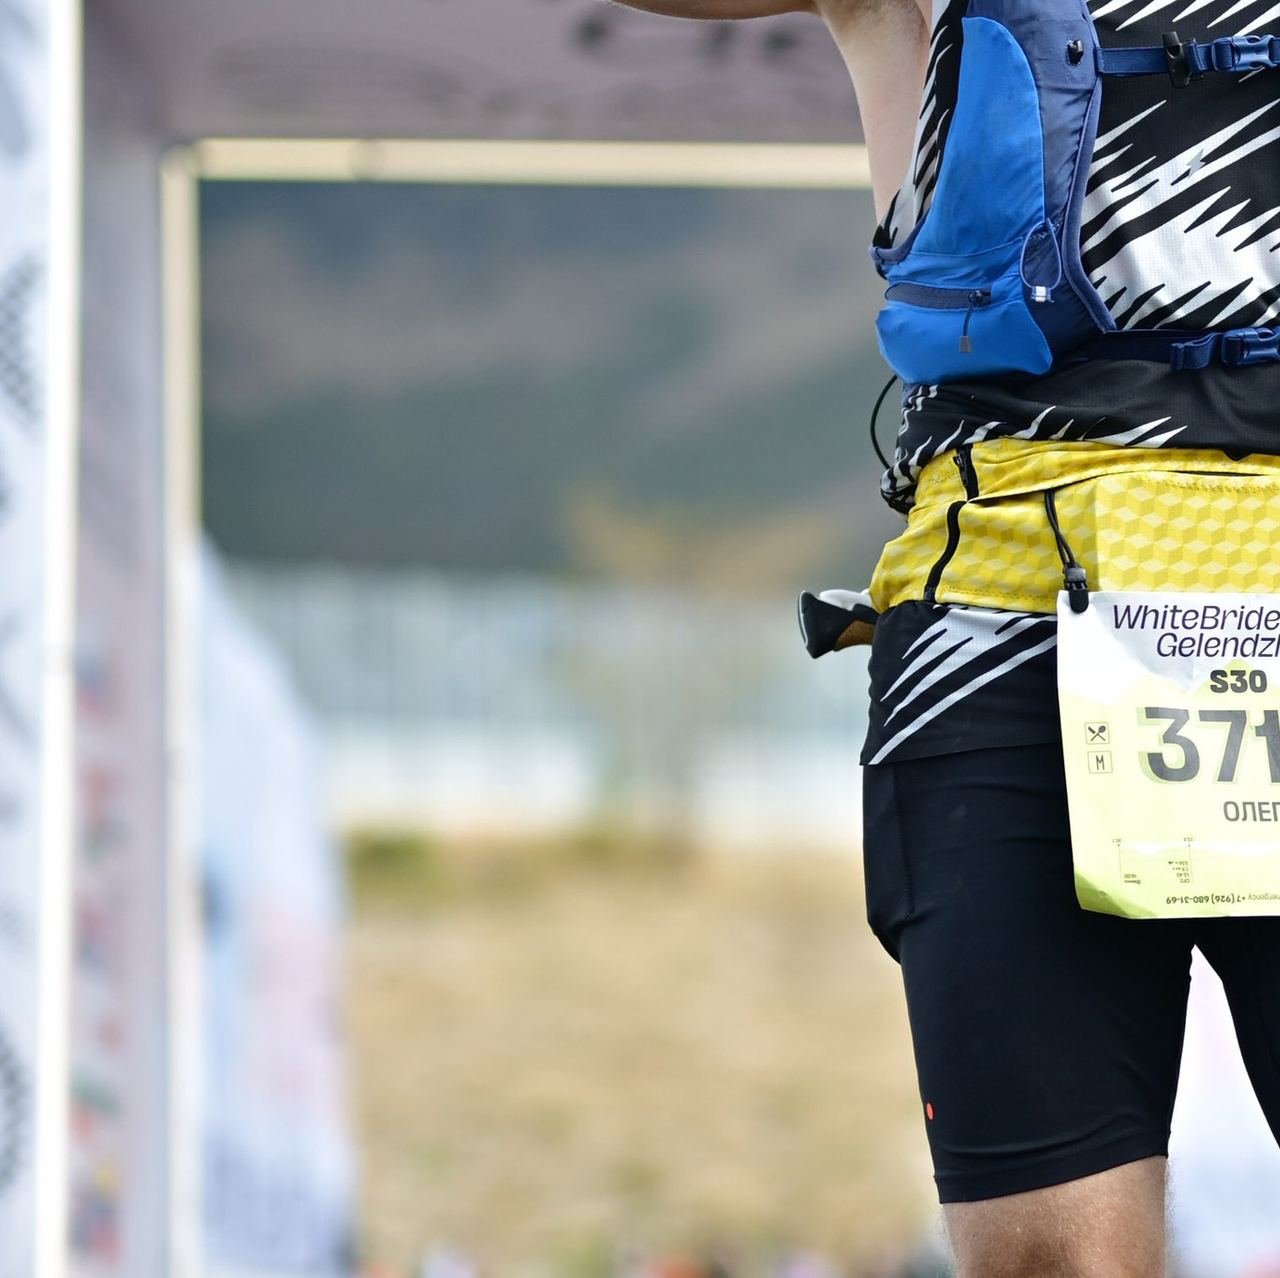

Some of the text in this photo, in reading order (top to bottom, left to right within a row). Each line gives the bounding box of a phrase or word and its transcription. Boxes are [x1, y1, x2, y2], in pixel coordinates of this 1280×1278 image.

[1209, 669, 1268, 694] S30
[1165, 894, 1210, 904] 680-31-69
[1211, 893, 1235, 905] (926)
